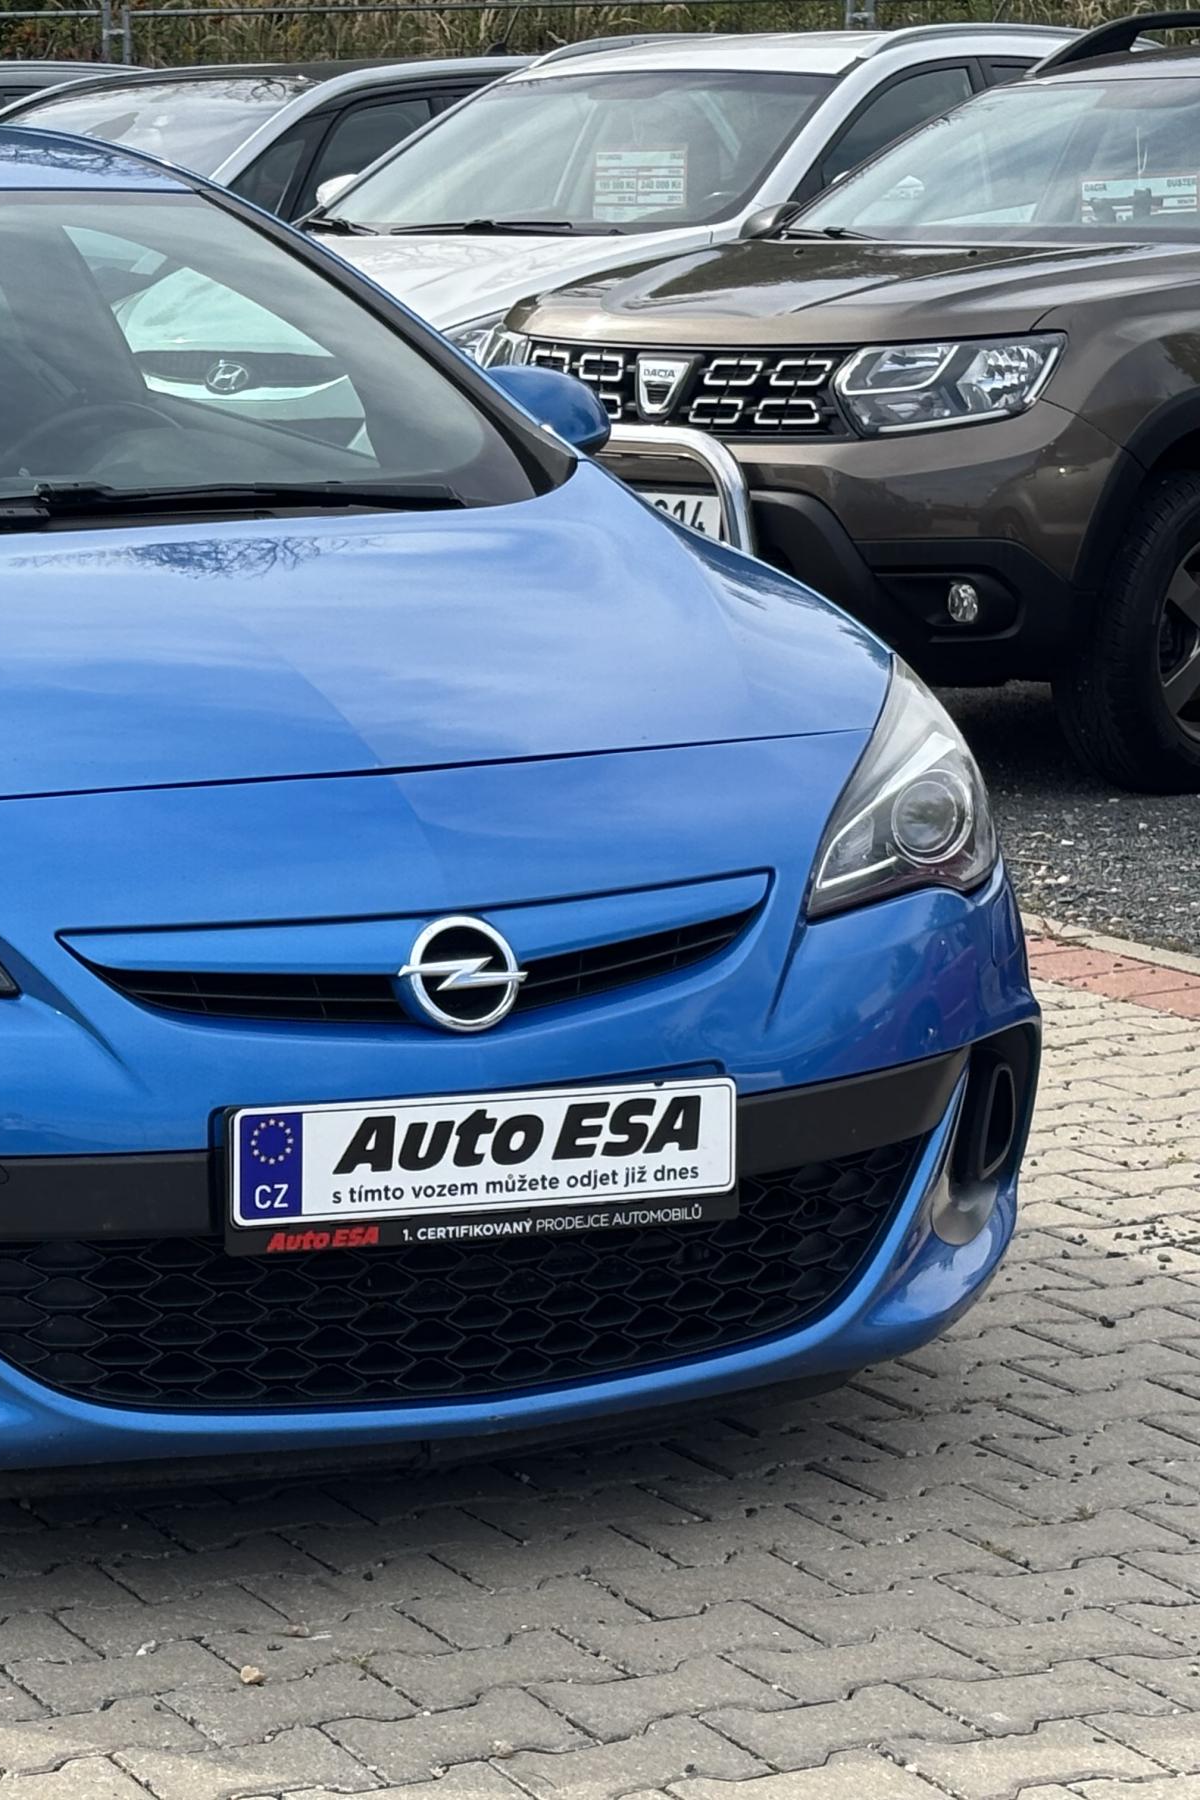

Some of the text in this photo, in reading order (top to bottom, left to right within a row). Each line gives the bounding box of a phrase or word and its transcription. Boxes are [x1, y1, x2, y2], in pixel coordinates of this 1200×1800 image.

[643, 368, 675, 378] DACIA
[332, 1095, 702, 1175] Auto ESA
[254, 1183, 290, 1210] CZ
[332, 1165, 700, 1204] s tímto vozem můžete odjet již dnes
[402, 1203, 702, 1241] 1. CERTIFIKOVANÝ PRODEJCE AUTOMOBILŮ
[267, 1225, 380, 1253] Auto ESA
